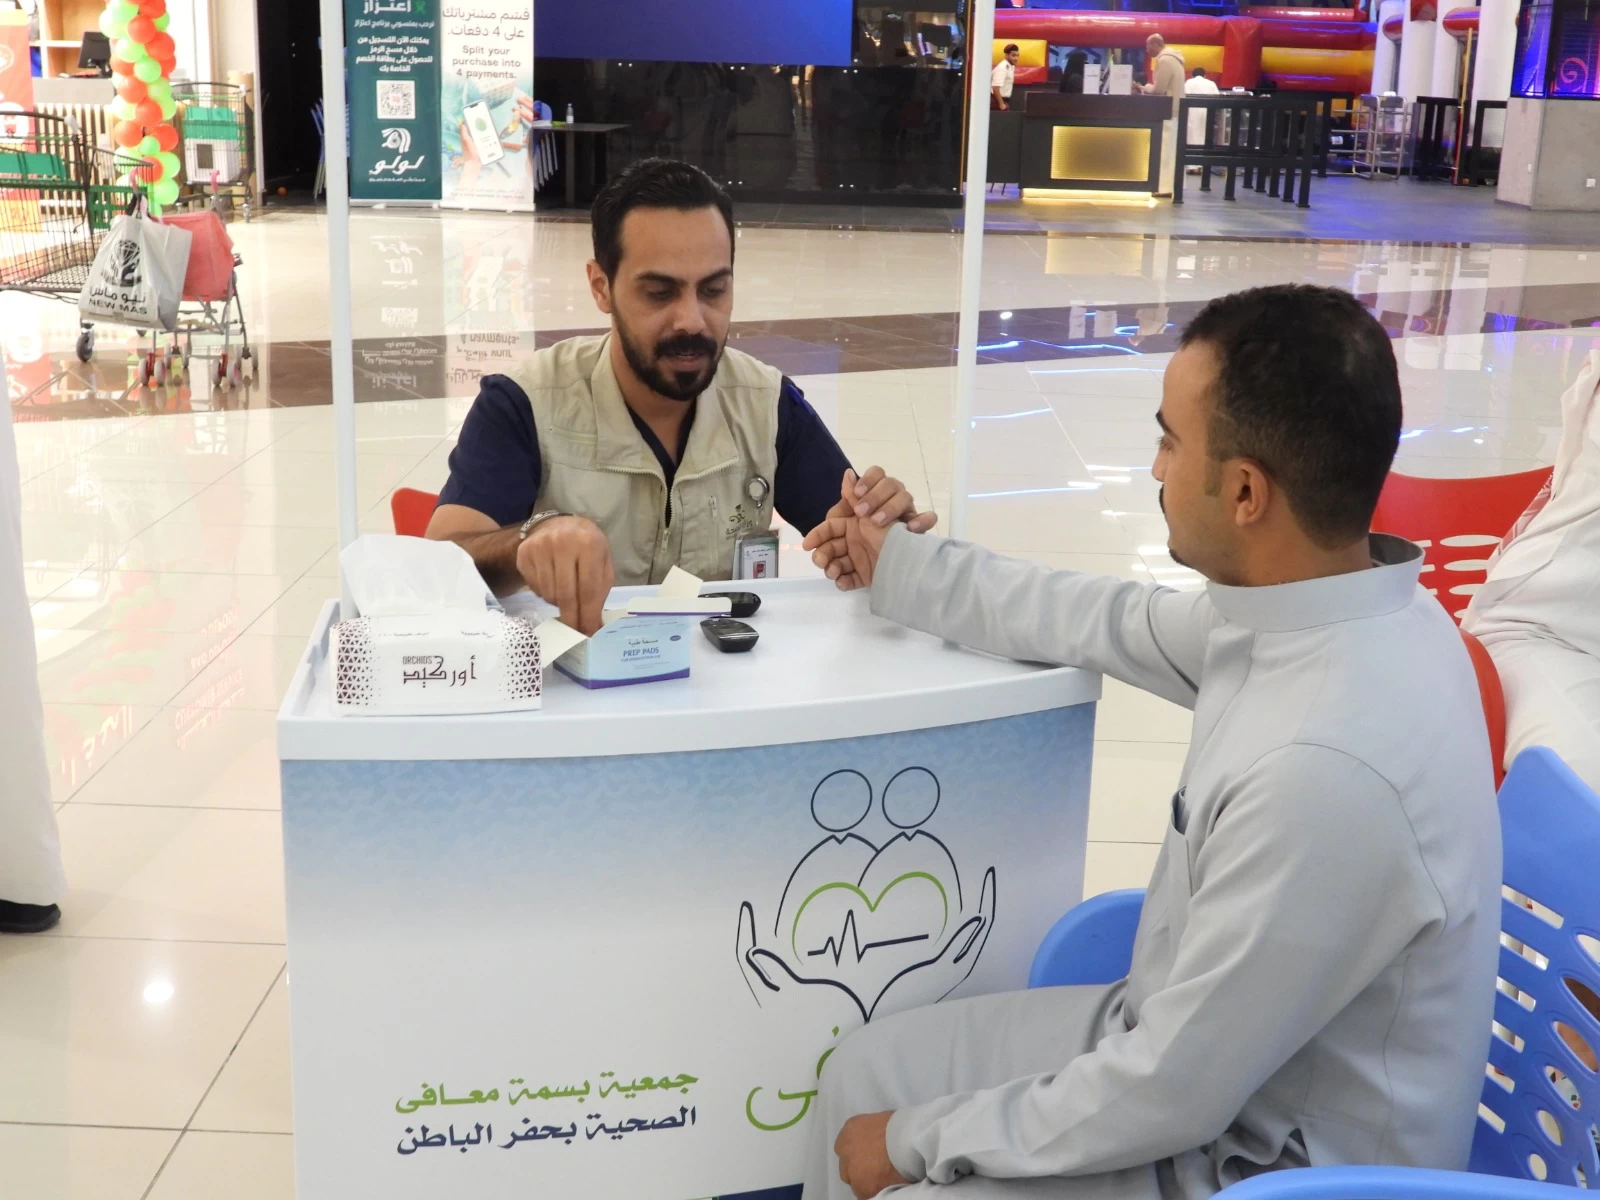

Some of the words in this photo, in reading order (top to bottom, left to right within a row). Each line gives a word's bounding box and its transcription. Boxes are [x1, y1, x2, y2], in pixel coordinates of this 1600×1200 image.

[492, 25, 501, 37] 4
[503, 26, 525, 41] على
[462, 45, 485, 56] Split
[488, 48, 511, 57] your
[452, 58, 499, 67] purchase
[501, 58, 521, 68] into
[456, 68, 463, 77] 4
[466, 69, 518, 80] payments.
[368, 155, 425, 176] لولو
[89, 298, 115, 310] NEW
[119, 304, 148, 315] MAS
[402, 655, 433, 665] ORCHIDS
[623, 649, 641, 658] PREP
[642, 647, 660, 656] PADS
[403, 654, 477, 689] أوركيد
[508, 1077, 591, 1106] بسمة
[598, 1071, 698, 1099] جمعية
[395, 1081, 500, 1114] معافى
[585, 1104, 696, 1140] الصحية
[396, 1121, 492, 1155] الباطن
[497, 1116, 577, 1149] بحفر
